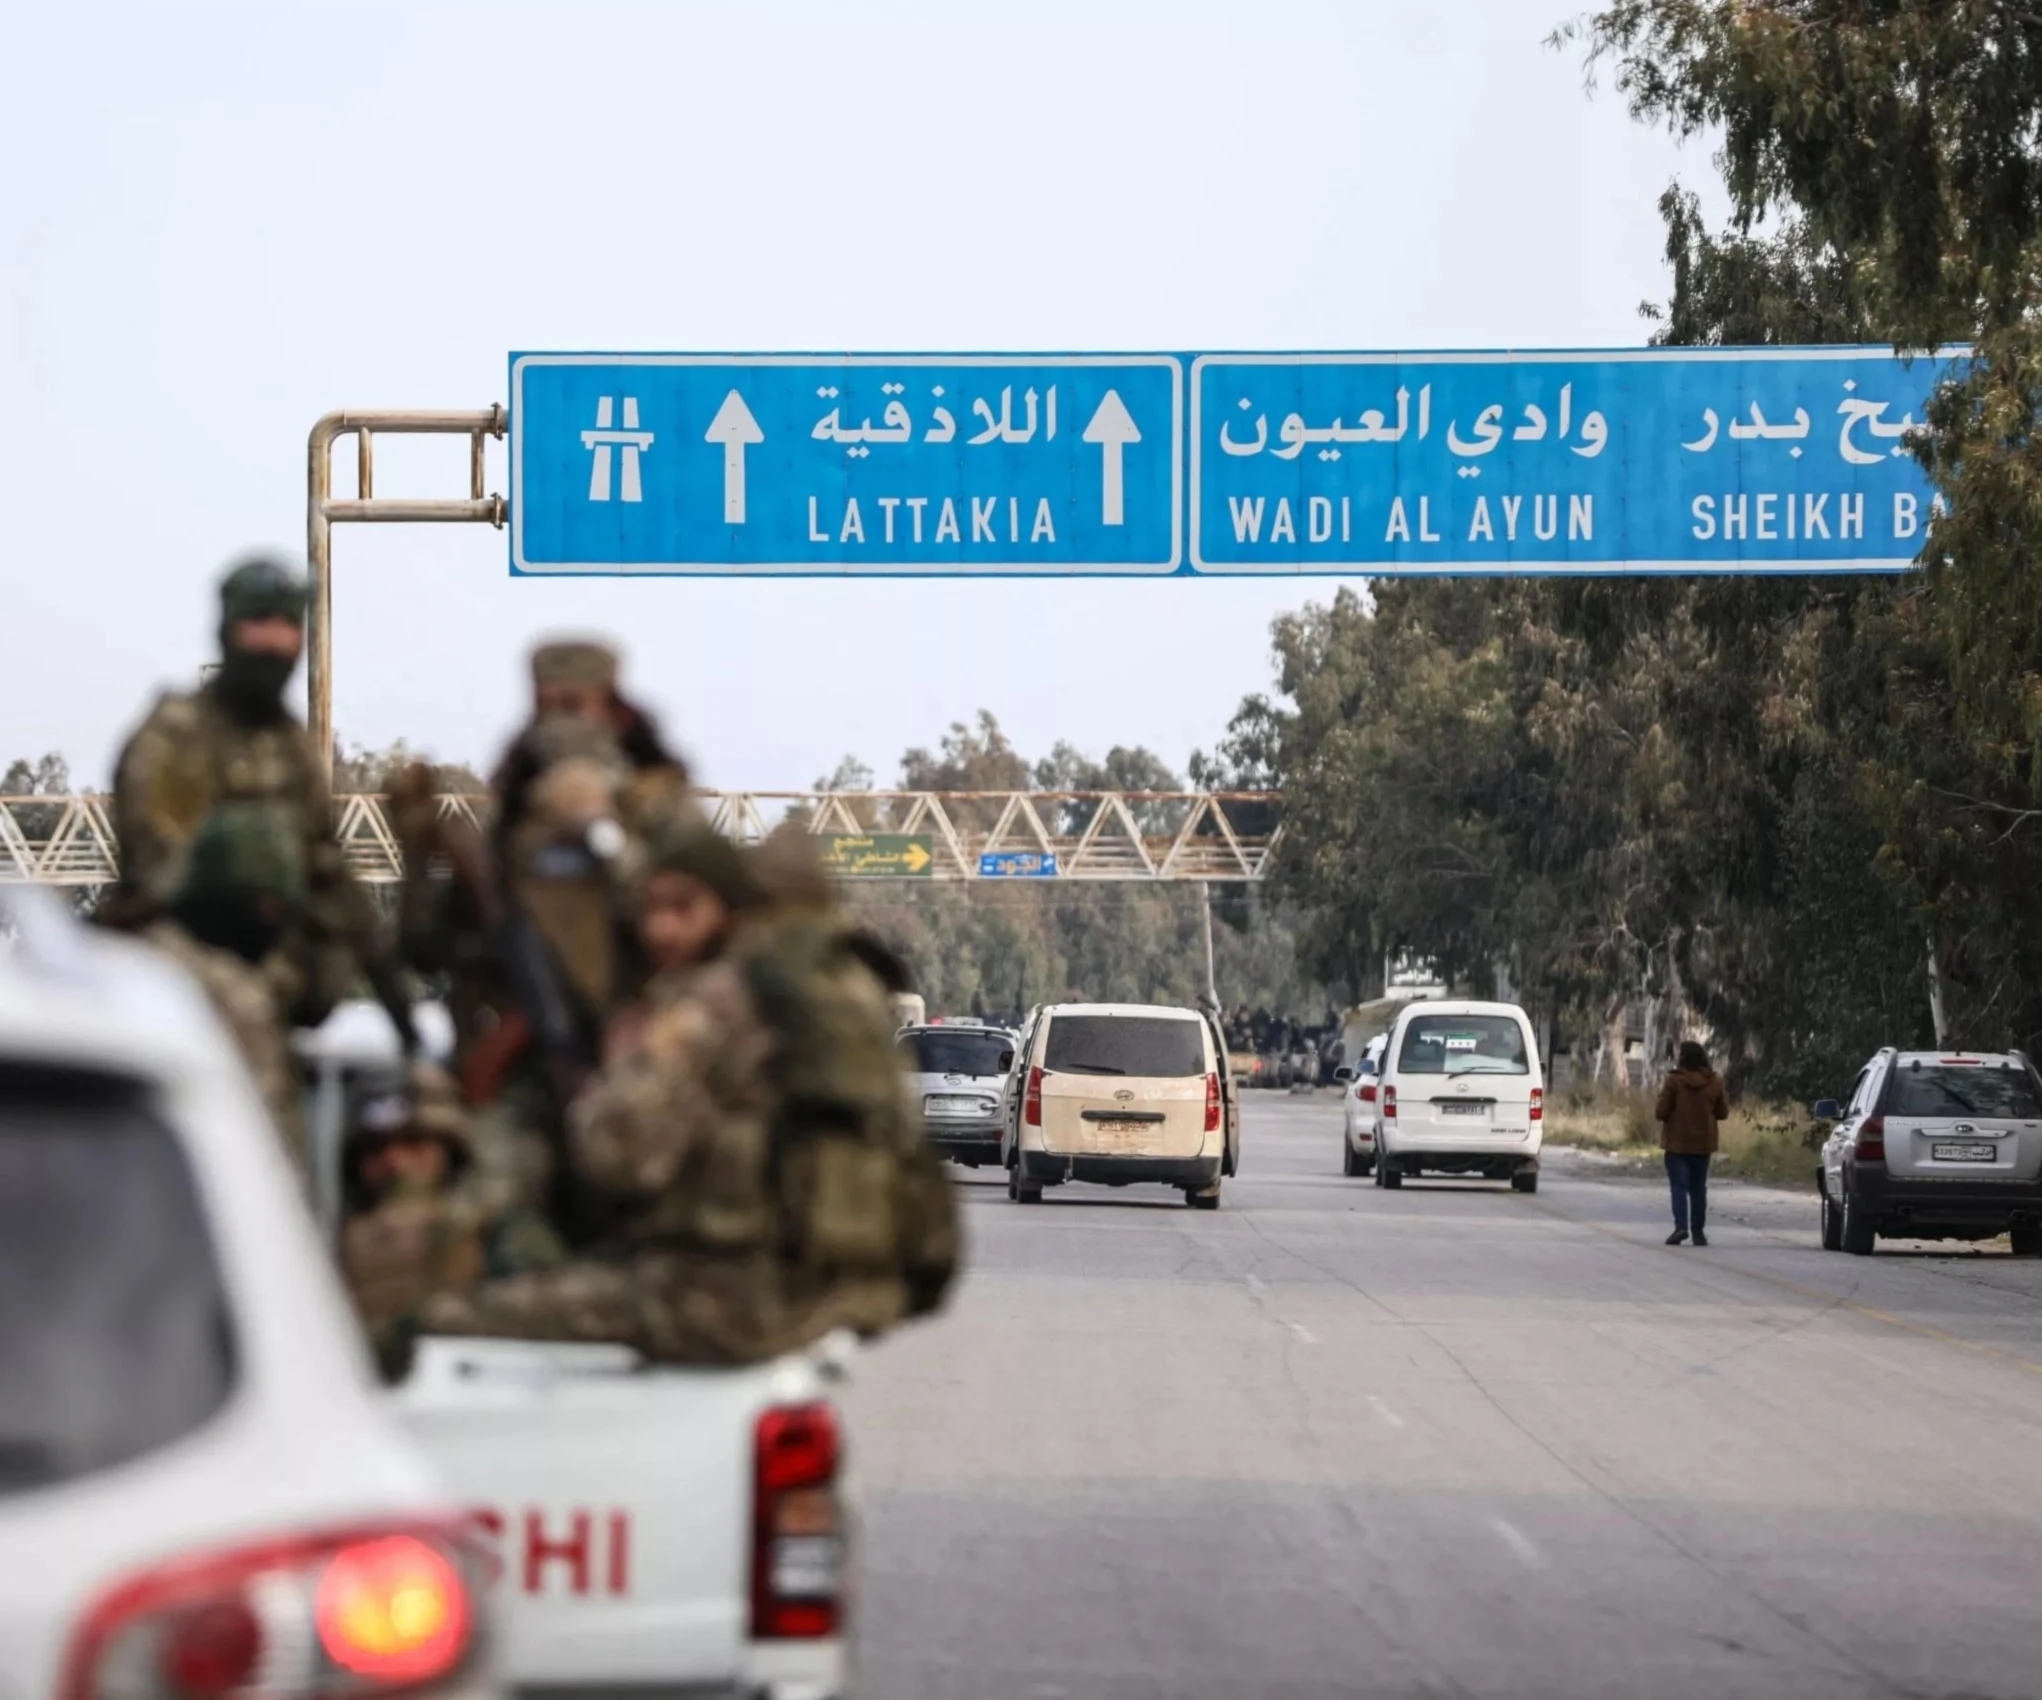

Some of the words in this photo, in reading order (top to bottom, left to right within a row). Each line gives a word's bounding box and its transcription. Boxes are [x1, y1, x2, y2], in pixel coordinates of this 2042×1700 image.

[810, 383, 1058, 459] اللاذقية
[1219, 382, 1432, 462] العيون
[1447, 381, 1609, 480] وادي
[1681, 400, 1812, 459] بدر
[1836, 379, 1932, 465] يخ
[809, 496, 1057, 544] LATTAKIA
[1229, 496, 1351, 544] WADI
[1385, 495, 1442, 543] AL
[1468, 494, 1594, 543] AYUN
[1692, 492, 1865, 541] SHEIKH
[1893, 492, 1947, 539] BA
